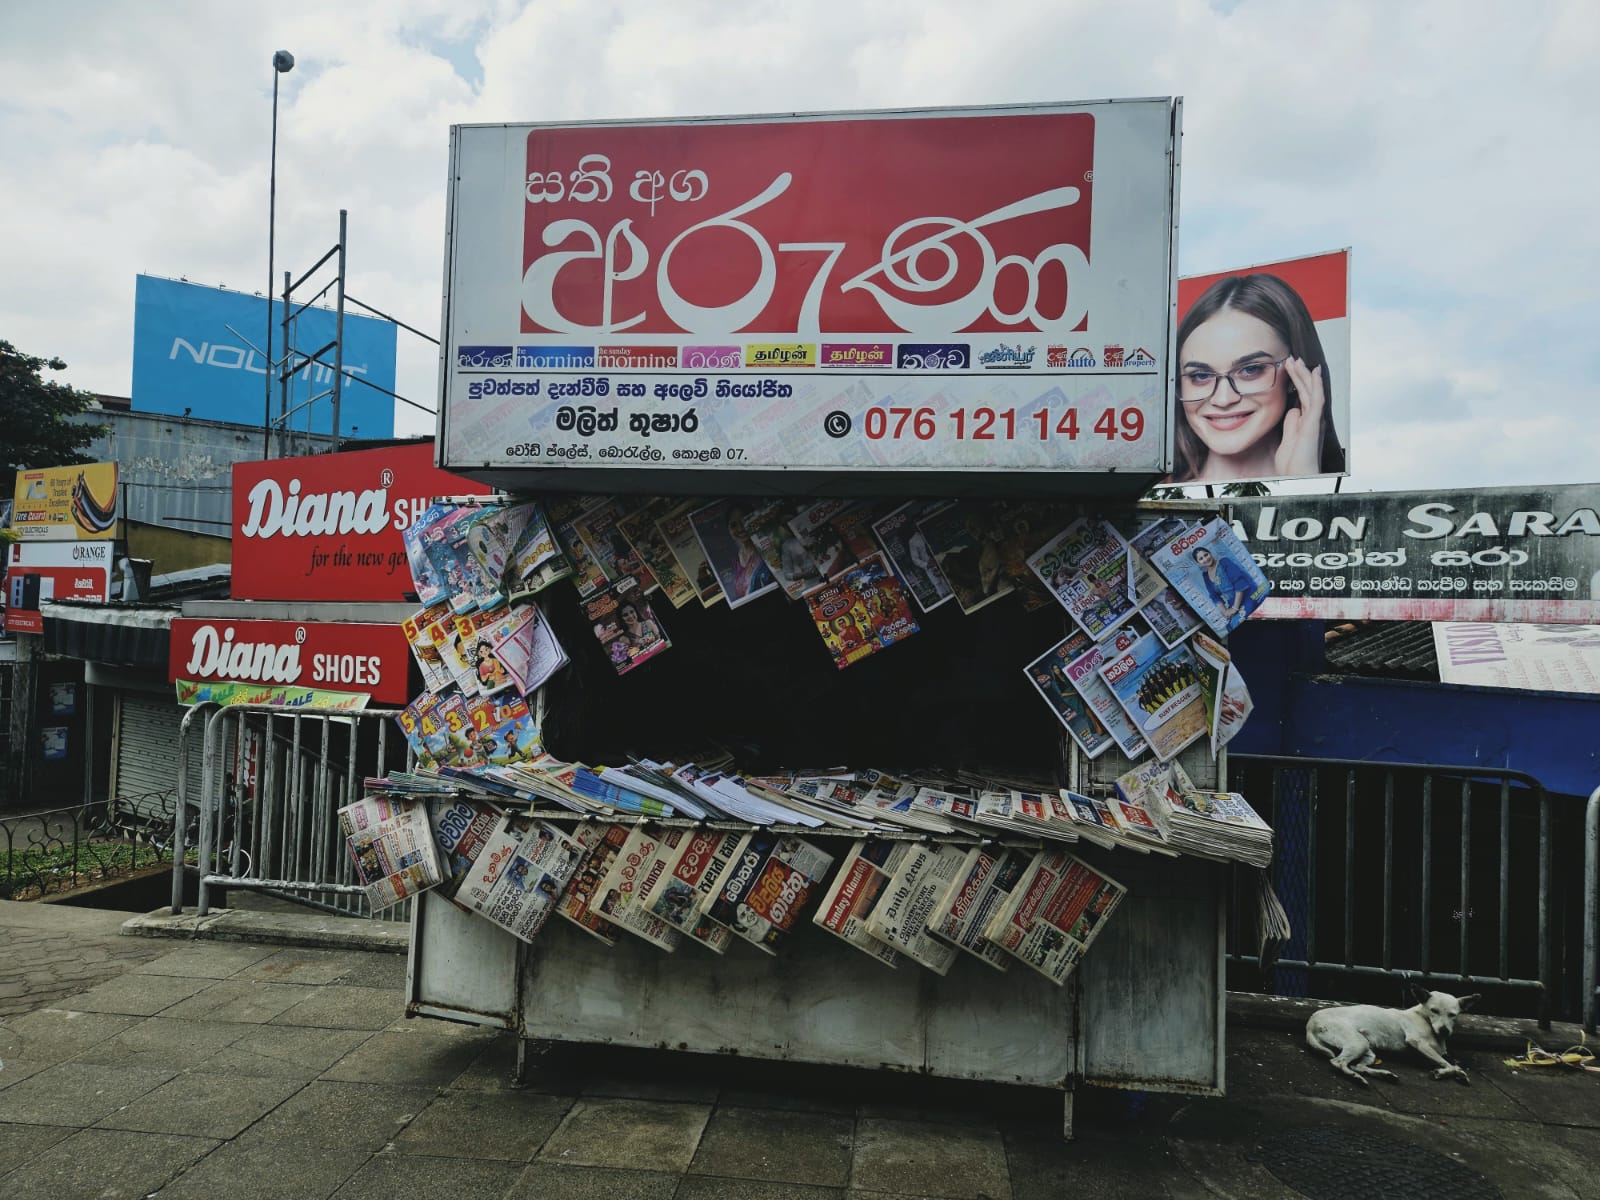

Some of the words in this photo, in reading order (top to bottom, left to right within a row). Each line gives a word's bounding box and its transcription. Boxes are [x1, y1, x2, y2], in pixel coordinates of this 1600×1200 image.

[526, 153, 612, 204] සති
[630, 170, 709, 219] අග
[520, 170, 1089, 334] අරුණ
[517, 353, 595, 369] morning
[599, 353, 678, 369] morning
[609, 347, 632, 356] sunday
[754, 344, 808, 362] தமிழன்
[829, 344, 885, 363] தமிழன்
[1068, 356, 1096, 368] auto
[1124, 358, 1156, 368] property
[468, 378, 540, 400] පුවත්පත්
[616, 382, 646, 397] සහ
[654, 379, 708, 401] අලෙවි
[556, 406, 618, 436] මලිත්
[629, 408, 699, 437] තුෂාර
[865, 407, 936, 441] 076
[950, 407, 1015, 441] 121
[1033, 407, 1080, 441] 14
[1094, 407, 1145, 442] 49
[726, 447, 748, 461] 07.
[242, 477, 393, 539] Diana
[1403, 502, 1600, 540] SARA
[310, 544, 331, 577] for
[333, 544, 352, 567] the
[356, 552, 383, 567] new
[1430, 547, 1529, 568] සරා
[1278, 577, 1306, 591] සහ
[1310, 574, 1346, 591] පිරිමි
[1472, 576, 1504, 592] සහ
[1509, 575, 1579, 593] සැකසීම
[404, 620, 418, 640] 5
[430, 626, 445, 642] 4
[459, 619, 473, 636] 3
[186, 625, 302, 684] Diana
[312, 653, 382, 685] SHOES
[400, 711, 416, 734] 5
[420, 714, 435, 737] 4
[445, 709, 460, 732] 3
[473, 708, 490, 731] 2
[885, 885, 914, 921] Daily
[904, 852, 927, 886] News
[825, 897, 851, 931] Sunday
[895, 903, 922, 940] COLOMBO
[914, 885, 930, 905] PORT
[898, 910, 926, 947] ACHIEVES
[917, 883, 938, 912] RECORD
[909, 897, 938, 938] MILESTONE
